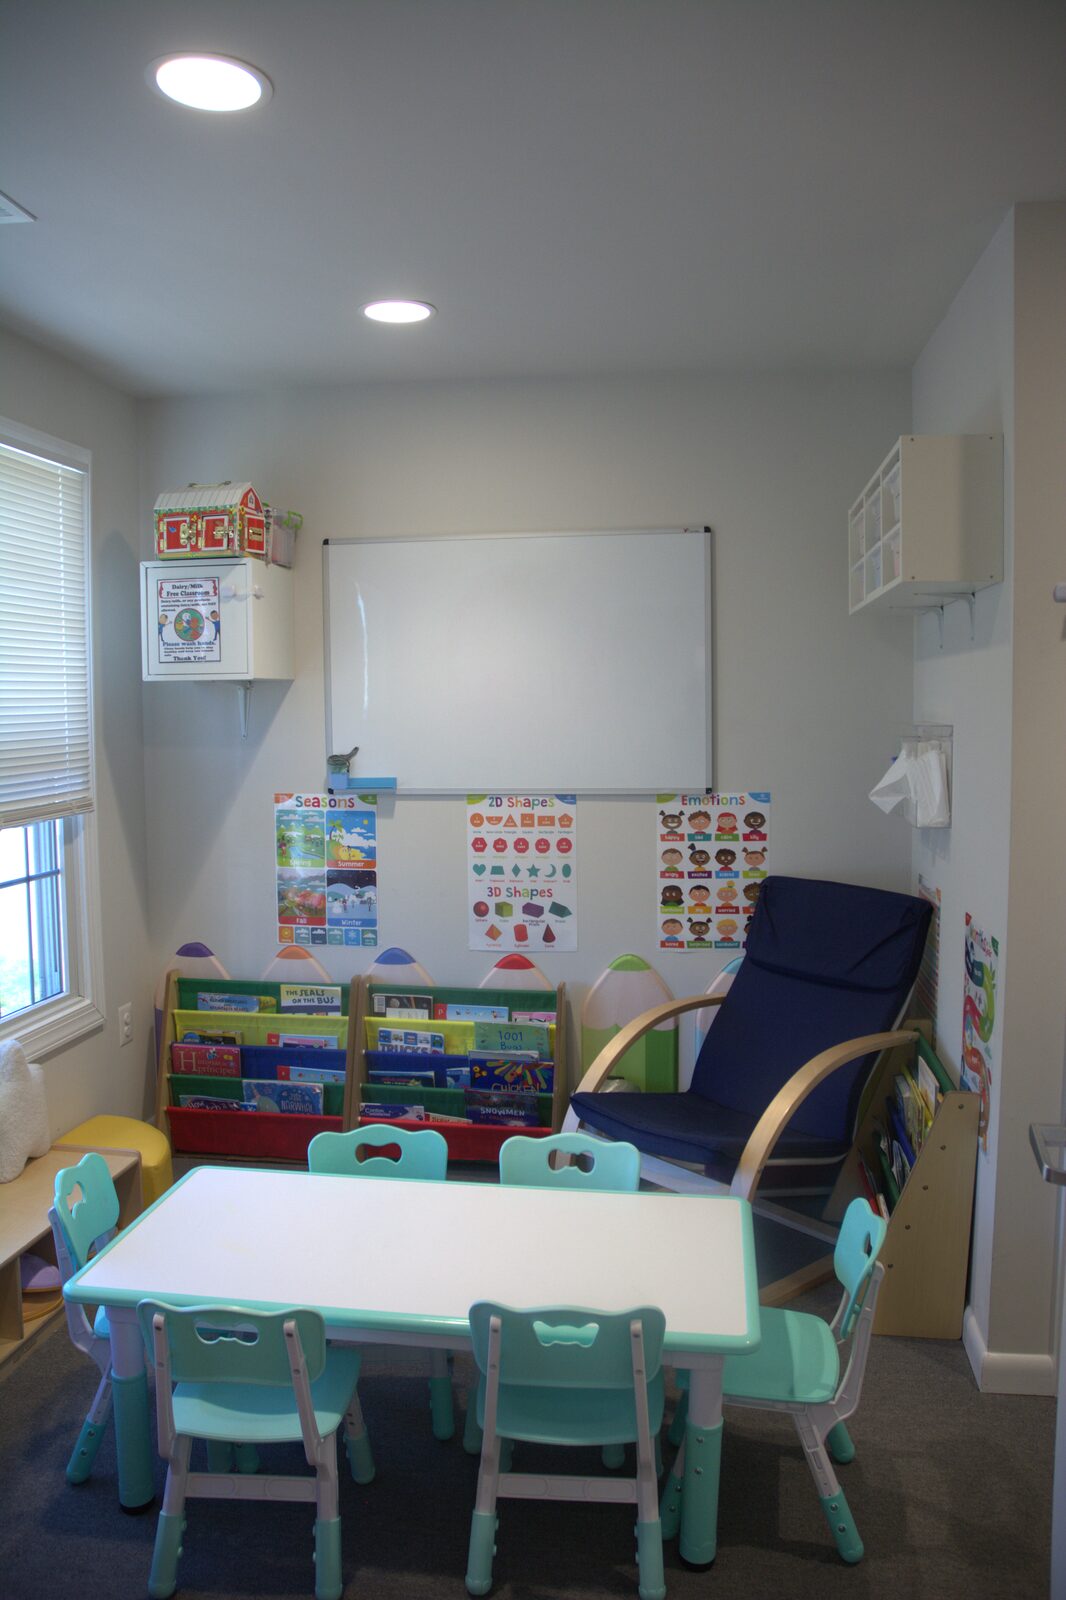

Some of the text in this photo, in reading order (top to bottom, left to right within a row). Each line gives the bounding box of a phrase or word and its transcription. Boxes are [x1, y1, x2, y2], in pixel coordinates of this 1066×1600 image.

[295, 795, 355, 808] Seasons
[488, 795, 555, 810] 2D Shapes
[681, 794, 746, 806] Emotions
[487, 886, 553, 900] 3D Shapes
[341, 919, 362, 927] Winter
[299, 989, 325, 997] SEALS
[316, 996, 335, 1004] BUS
[498, 1030, 523, 1041] 1001
[380, 1043, 430, 1054] TRUCKS
[480, 1106, 526, 1117] SNOWMEN
